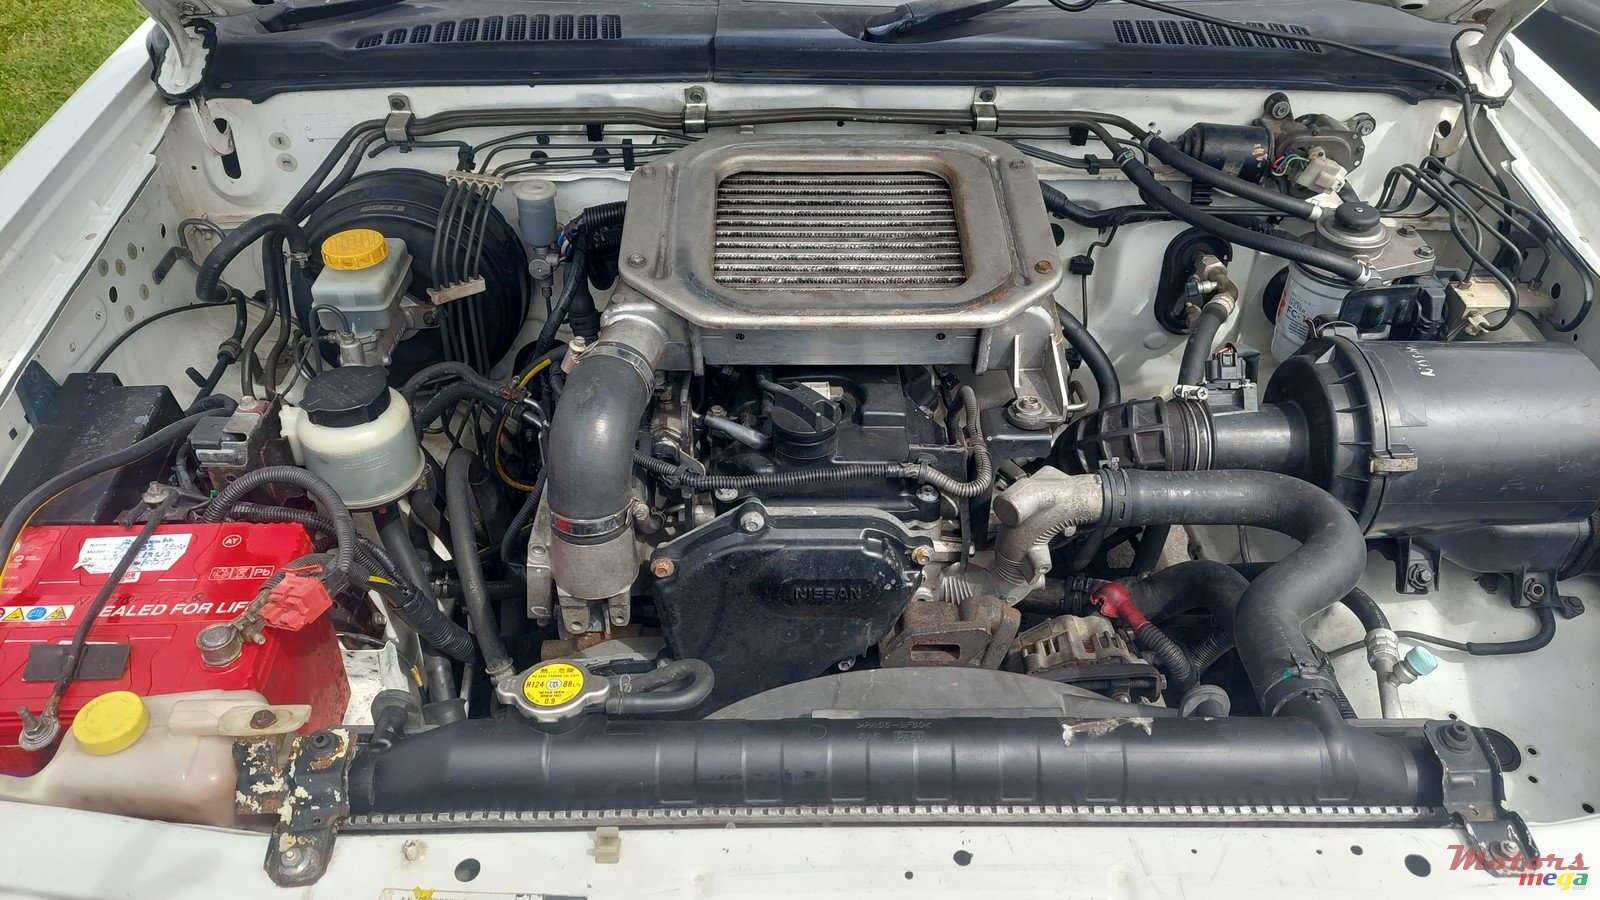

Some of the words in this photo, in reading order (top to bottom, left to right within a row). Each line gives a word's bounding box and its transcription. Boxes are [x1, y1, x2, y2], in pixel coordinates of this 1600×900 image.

[253, 568, 271, 577] Pb
[794, 587, 862, 599] NISSAN
[97, 603, 168, 617] EALED
[169, 602, 214, 615] FOR
[215, 601, 252, 614] LIF
